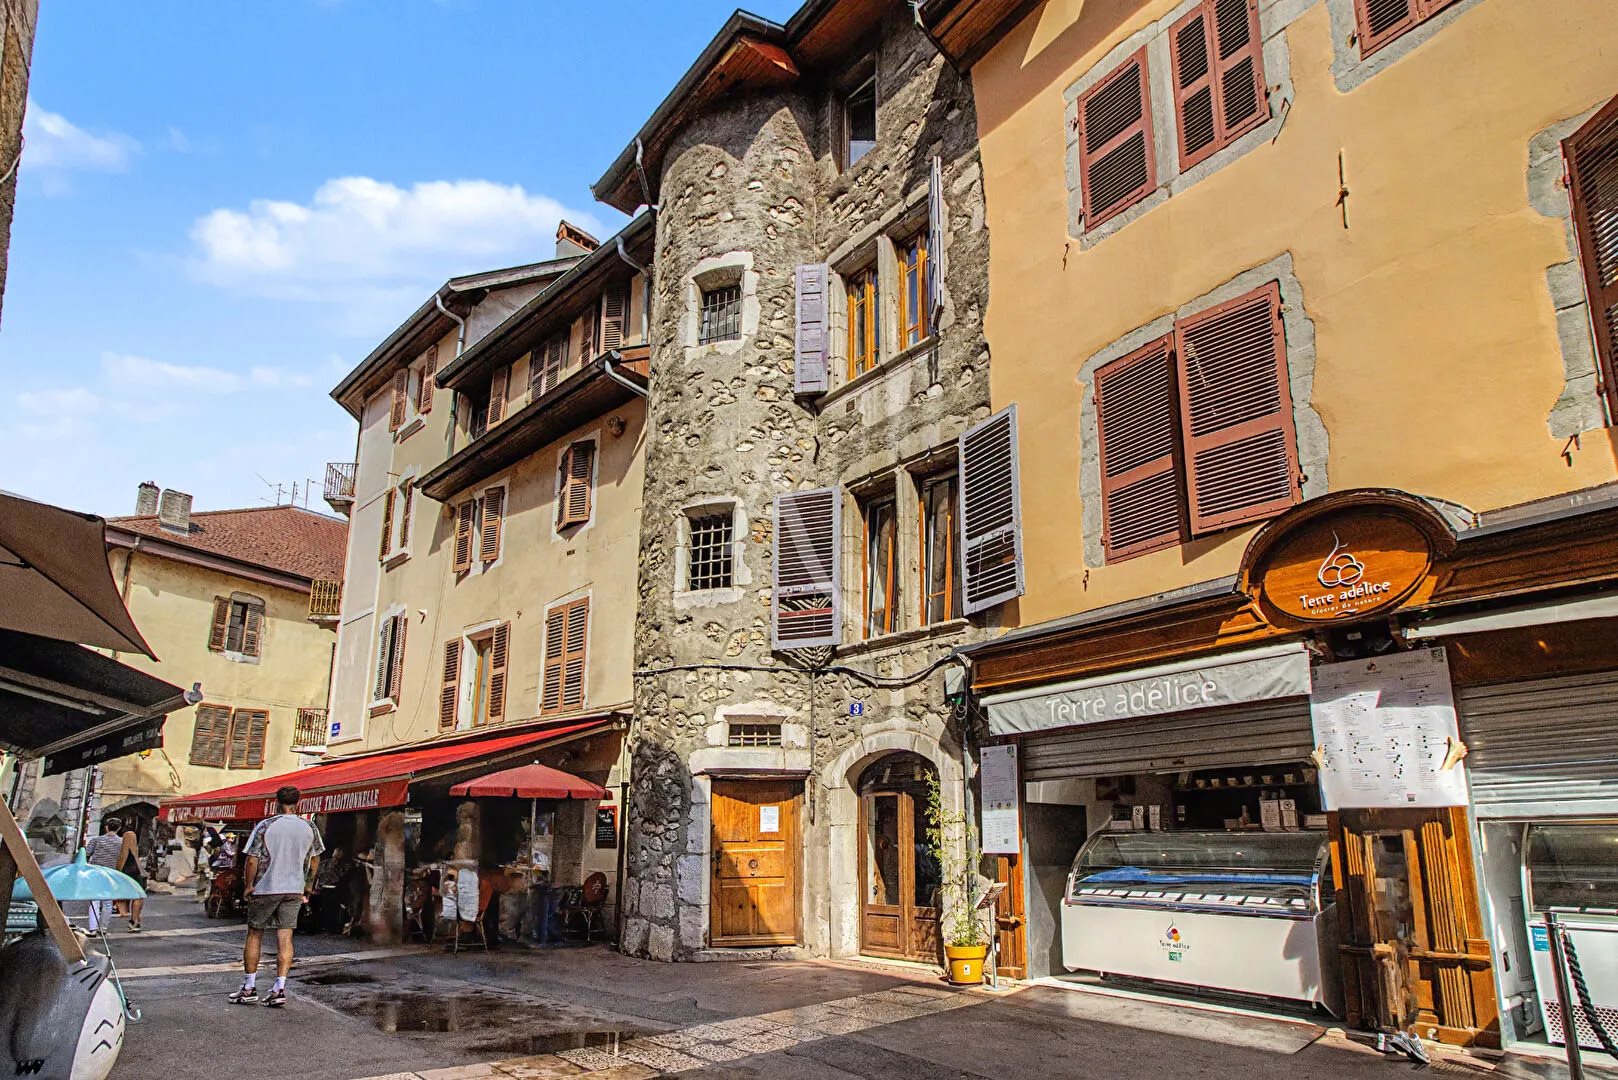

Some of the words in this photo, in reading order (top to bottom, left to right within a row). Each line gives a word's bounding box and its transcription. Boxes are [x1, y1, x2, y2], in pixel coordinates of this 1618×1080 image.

[1299, 593, 1335, 609] Terre
[1339, 581, 1392, 601] adélice
[1046, 697, 1106, 723] Terre
[1114, 679, 1218, 714] adélice
[324, 789, 379, 811] TRADITIONNELLE
